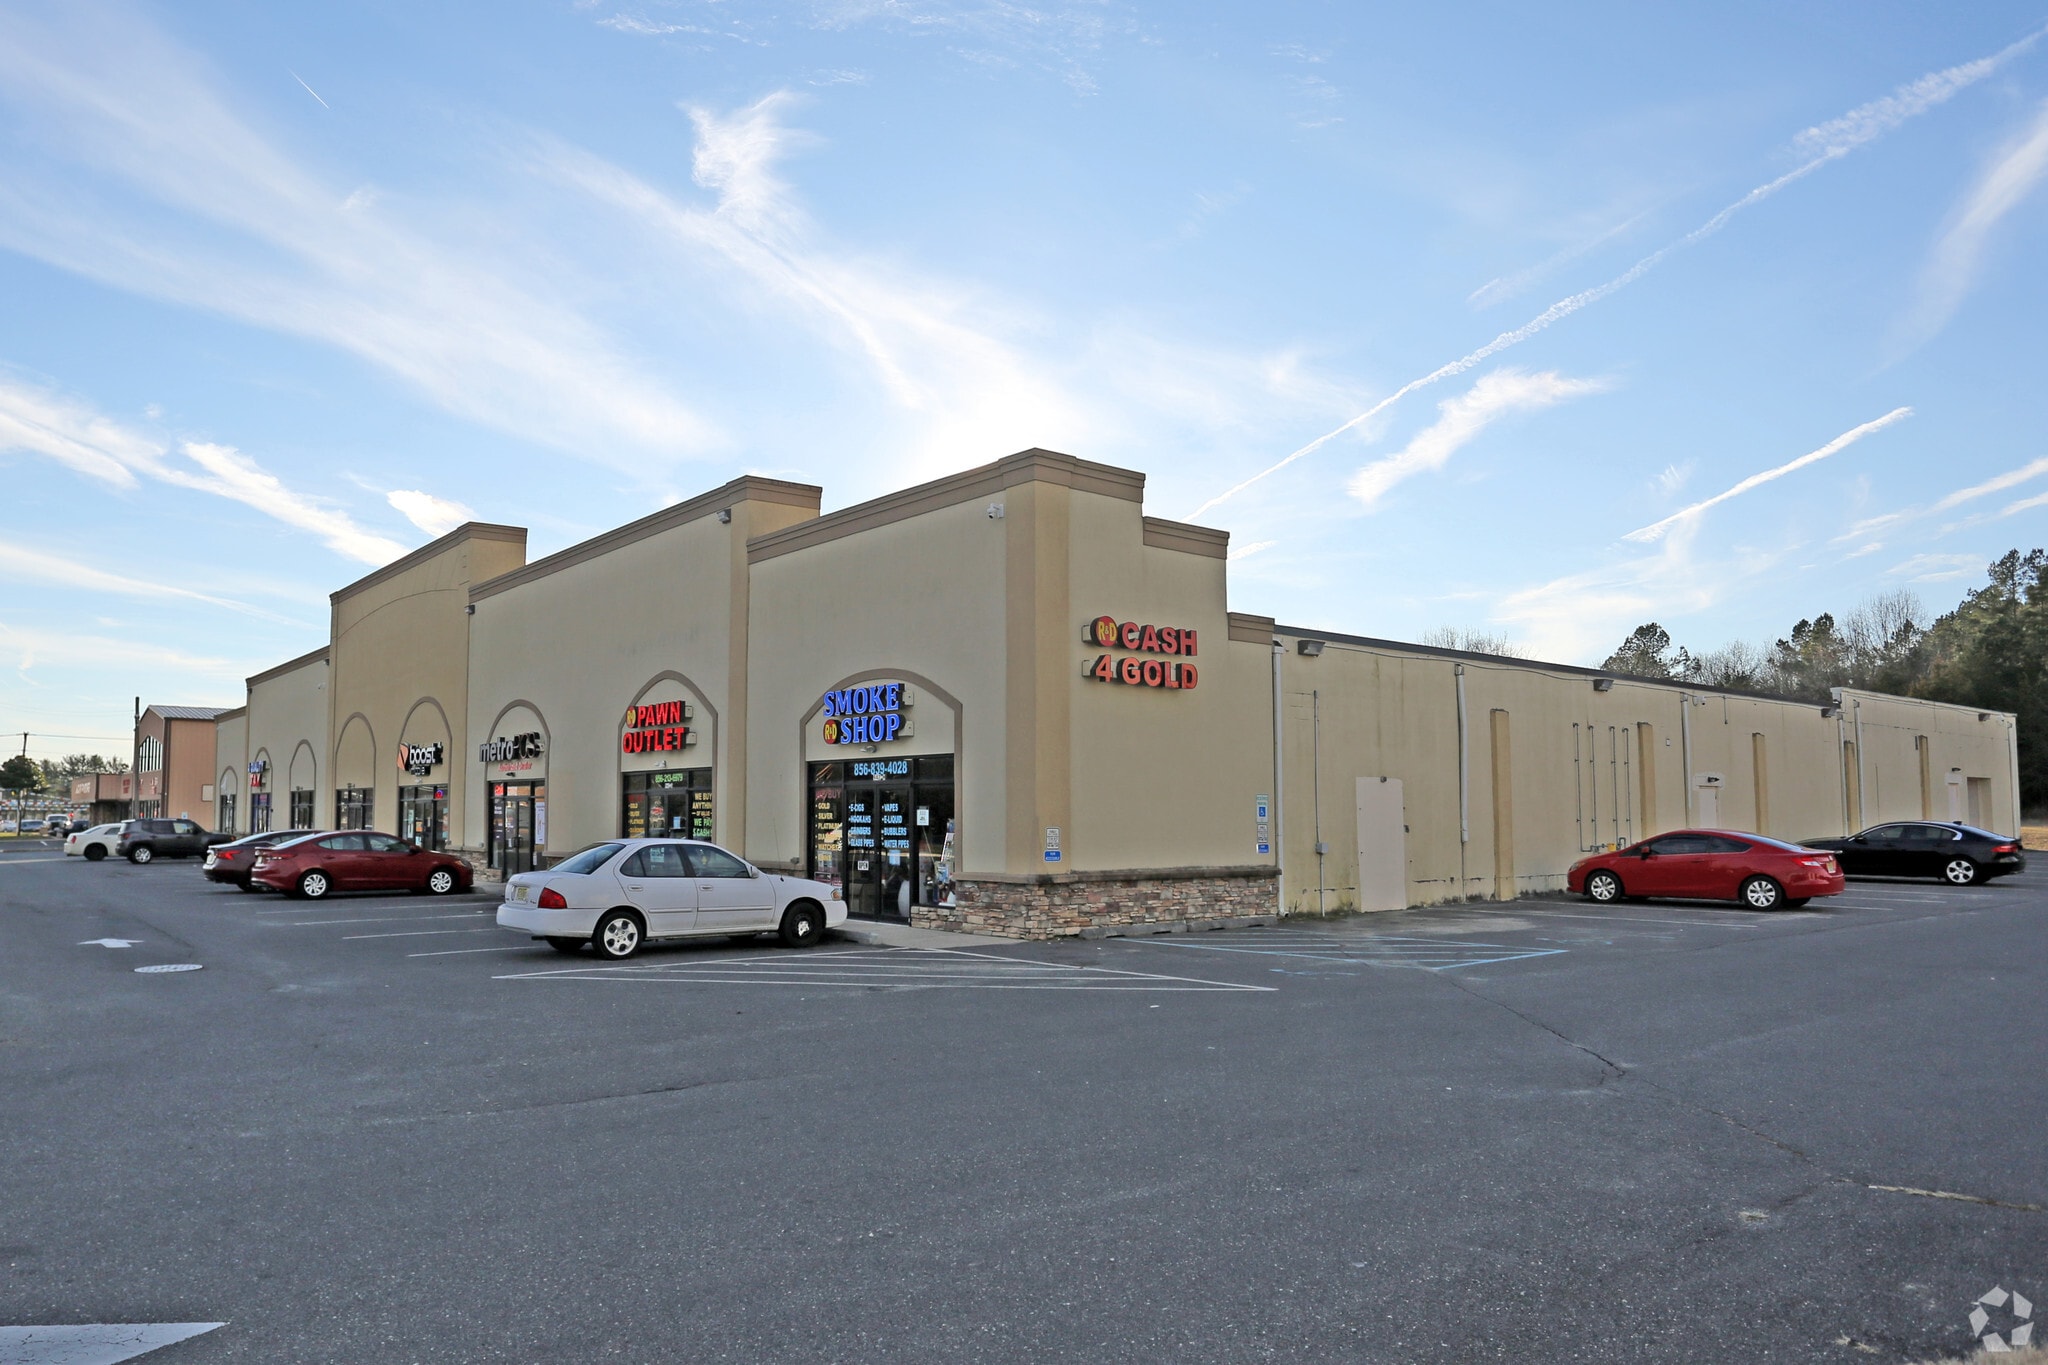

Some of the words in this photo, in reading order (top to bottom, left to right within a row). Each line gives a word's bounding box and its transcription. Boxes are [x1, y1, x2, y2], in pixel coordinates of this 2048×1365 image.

[1097, 621, 1118, 642] R&D
[1121, 621, 1198, 657] CASH
[1095, 654, 1114, 683] 4
[1121, 656, 1198, 690] GOLD
[823, 683, 900, 718] SMOKE
[637, 700, 682, 728] PAWN
[840, 713, 901, 745] SHOP
[622, 726, 686, 754] OUTLET
[409, 744, 436, 764] boost
[854, 761, 908, 776] 856-839-4028
[818, 802, 831, 810] GOLD
[818, 812, 833, 820] SILVER
[884, 803, 899, 812] VAPES
[884, 815, 903, 823] E-LIQUID
[884, 827, 907, 836] BUBBLERS
